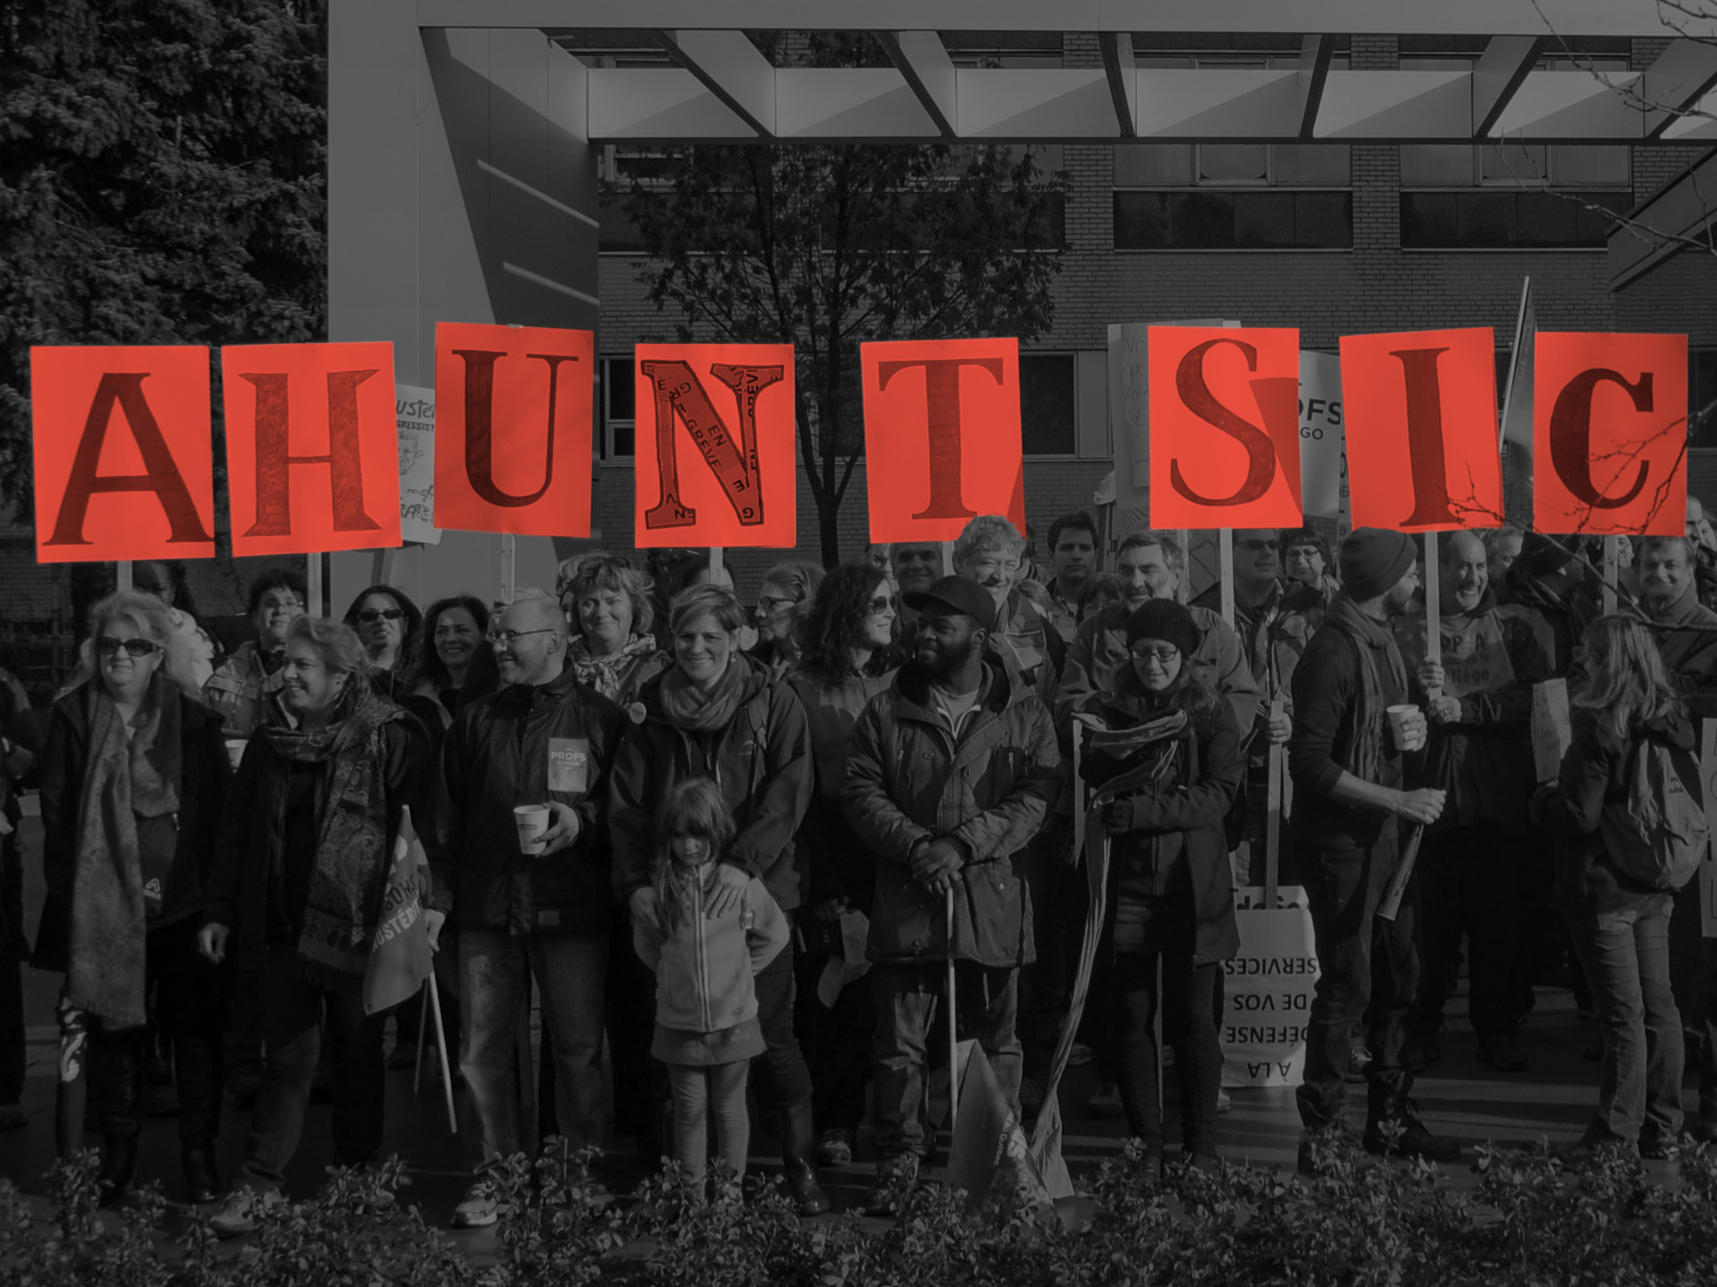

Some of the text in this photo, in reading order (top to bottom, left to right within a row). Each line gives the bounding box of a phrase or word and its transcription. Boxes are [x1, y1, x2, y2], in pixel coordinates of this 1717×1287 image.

[550, 751, 587, 762] PROFS
[1225, 959, 1317, 975] SERVICES
[1233, 993, 1307, 1011] DE VOS
[1247, 1061, 1291, 1082] À LA
